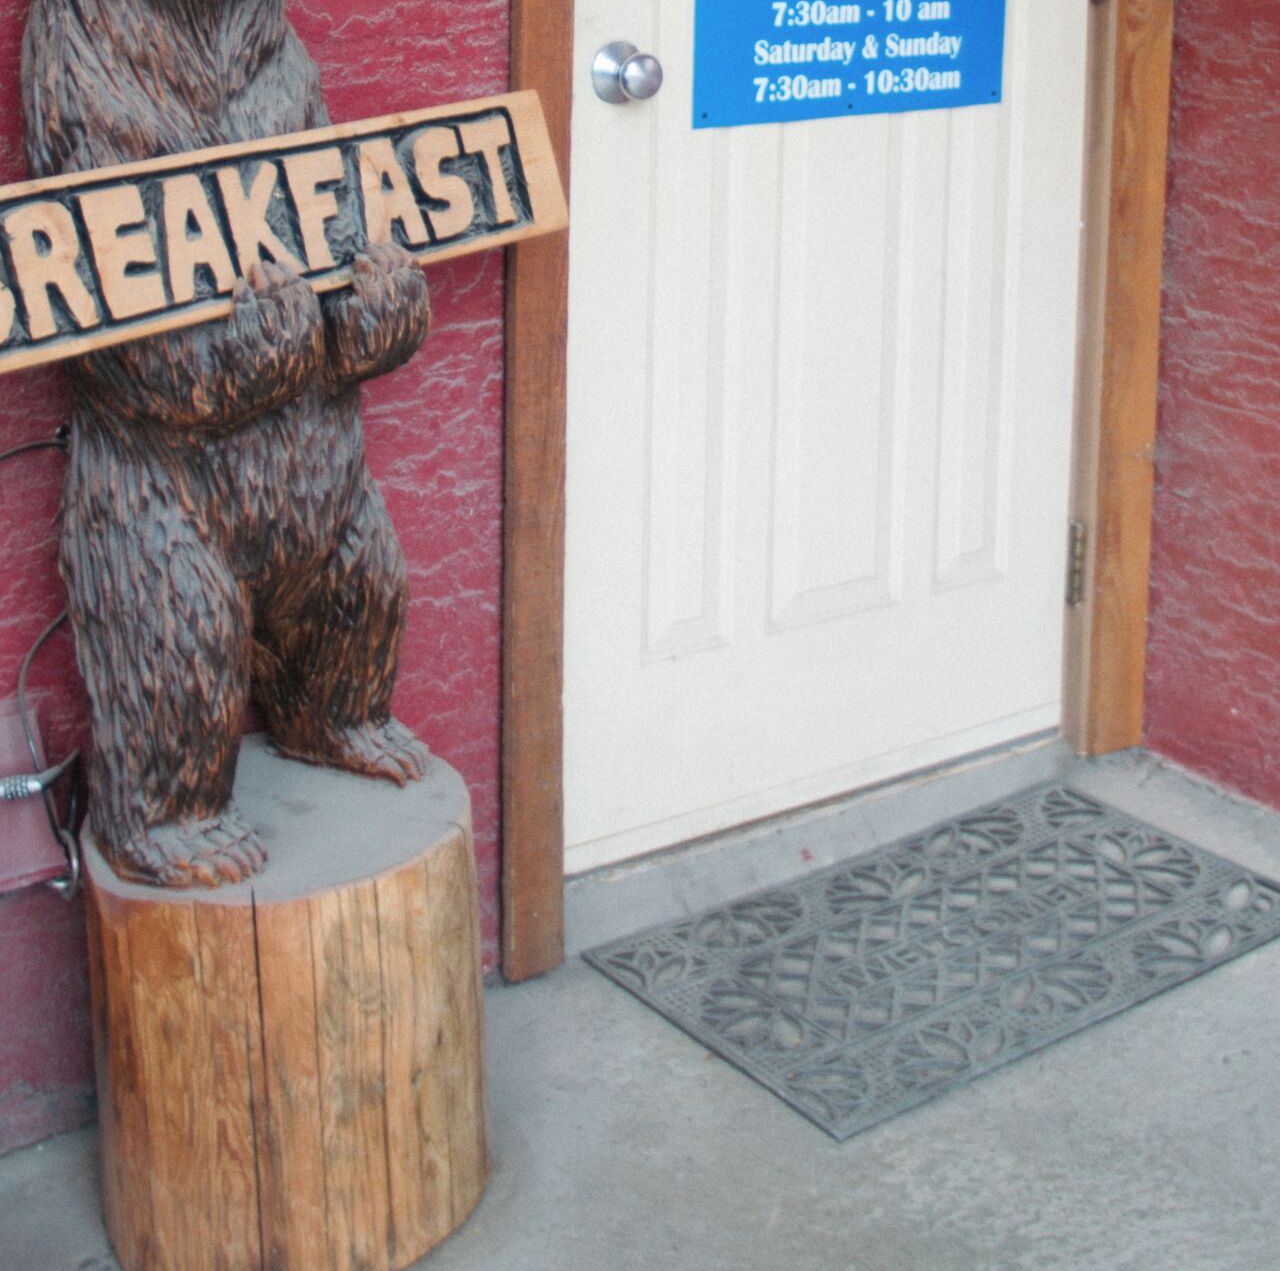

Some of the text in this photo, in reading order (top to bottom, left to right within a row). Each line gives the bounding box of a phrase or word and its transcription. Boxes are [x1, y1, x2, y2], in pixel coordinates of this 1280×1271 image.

[772, 1, 861, 27] 7:30am
[917, 1, 951, 21] am
[754, 31, 962, 65] Saturday & Sunday
[753, 74, 842, 103] 7:30am
[864, 67, 961, 94] 10:30am
[834, 882, 1082, 991] WELCOME
